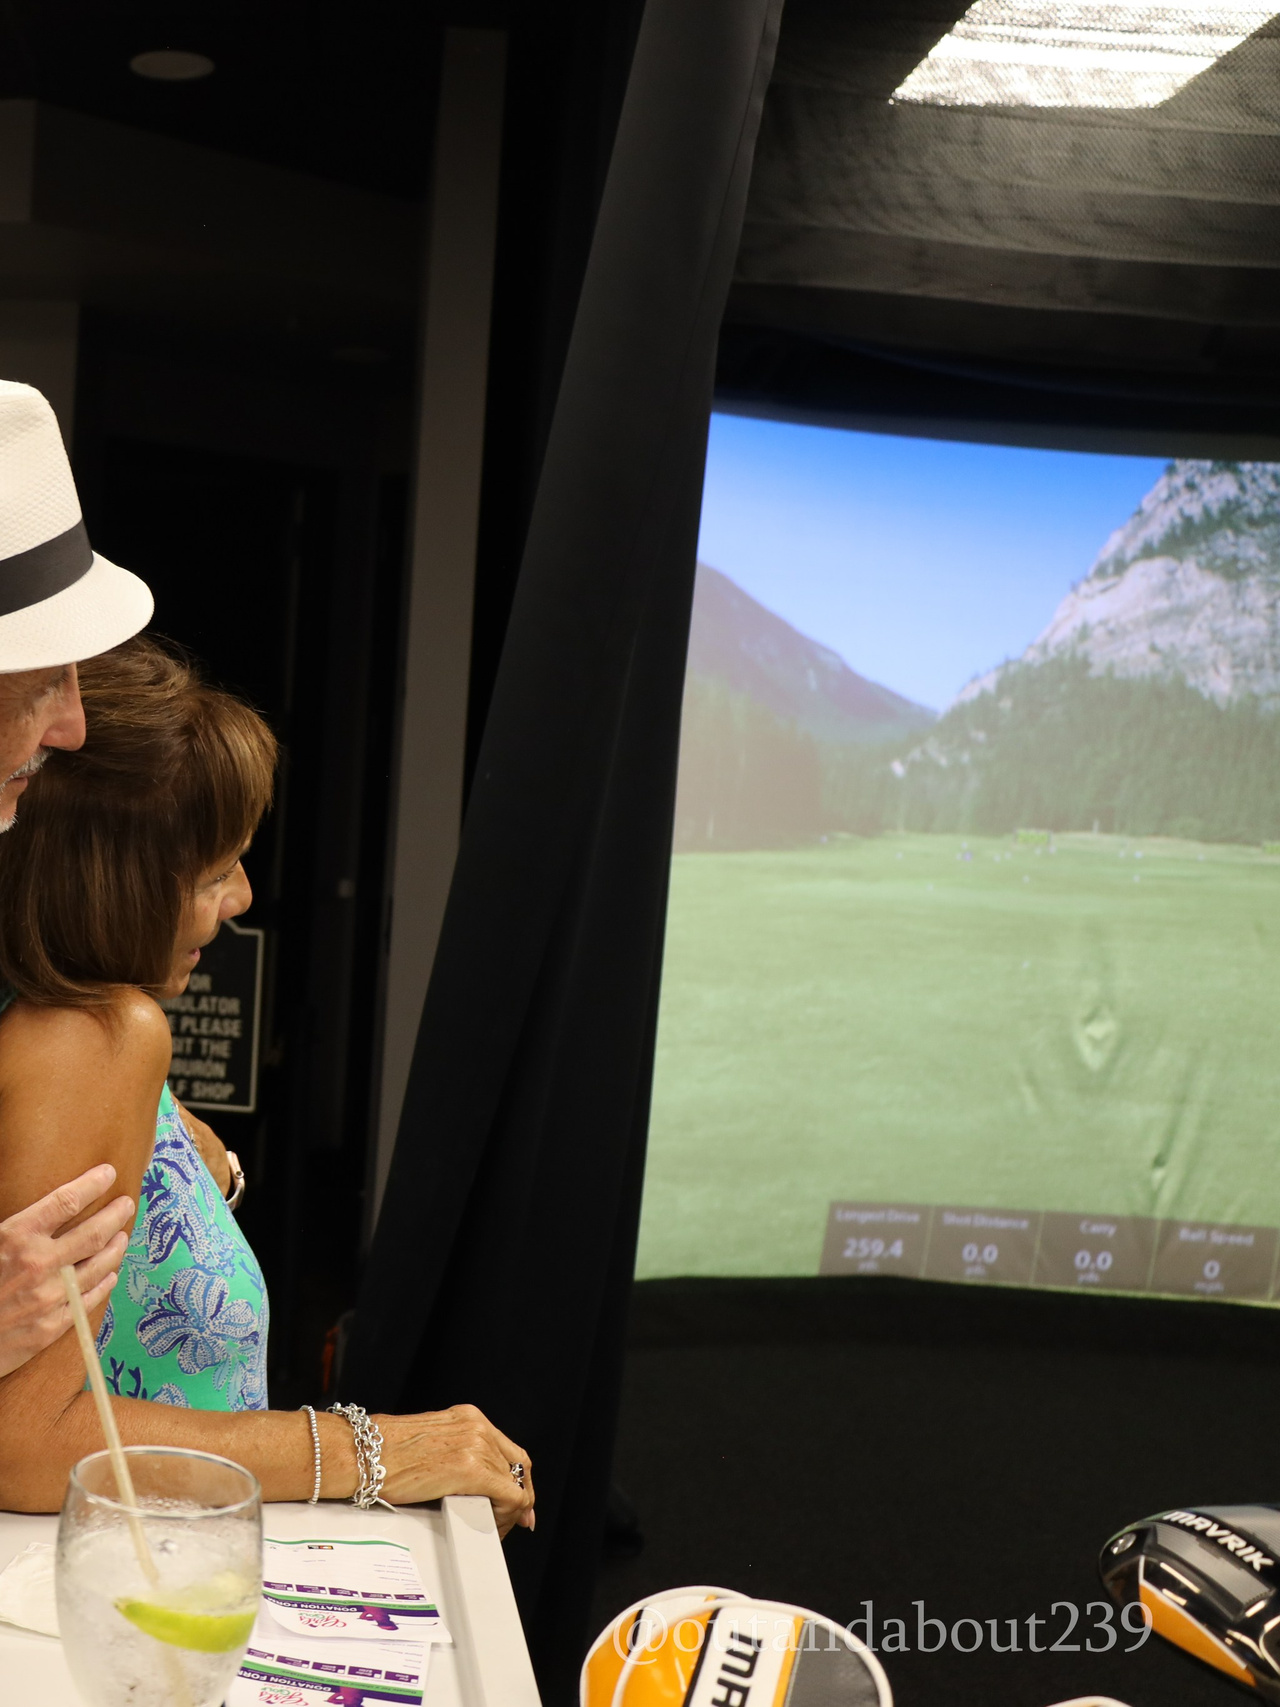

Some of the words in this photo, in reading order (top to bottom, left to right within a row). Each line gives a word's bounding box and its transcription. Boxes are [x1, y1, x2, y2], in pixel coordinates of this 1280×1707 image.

[1079, 1219, 1117, 1238] Carry
[843, 1237, 903, 1259] 259.4
[962, 1243, 998, 1264] 0.0
[1074, 1250, 1113, 1272] 0.0
[1203, 1260, 1221, 1280] 0
[1163, 1511, 1274, 1572] MAVRIK
[266, 1596, 297, 1607] FORM
[300, 1603, 358, 1612] DONATION
[269, 1676, 332, 1691] DONATION
